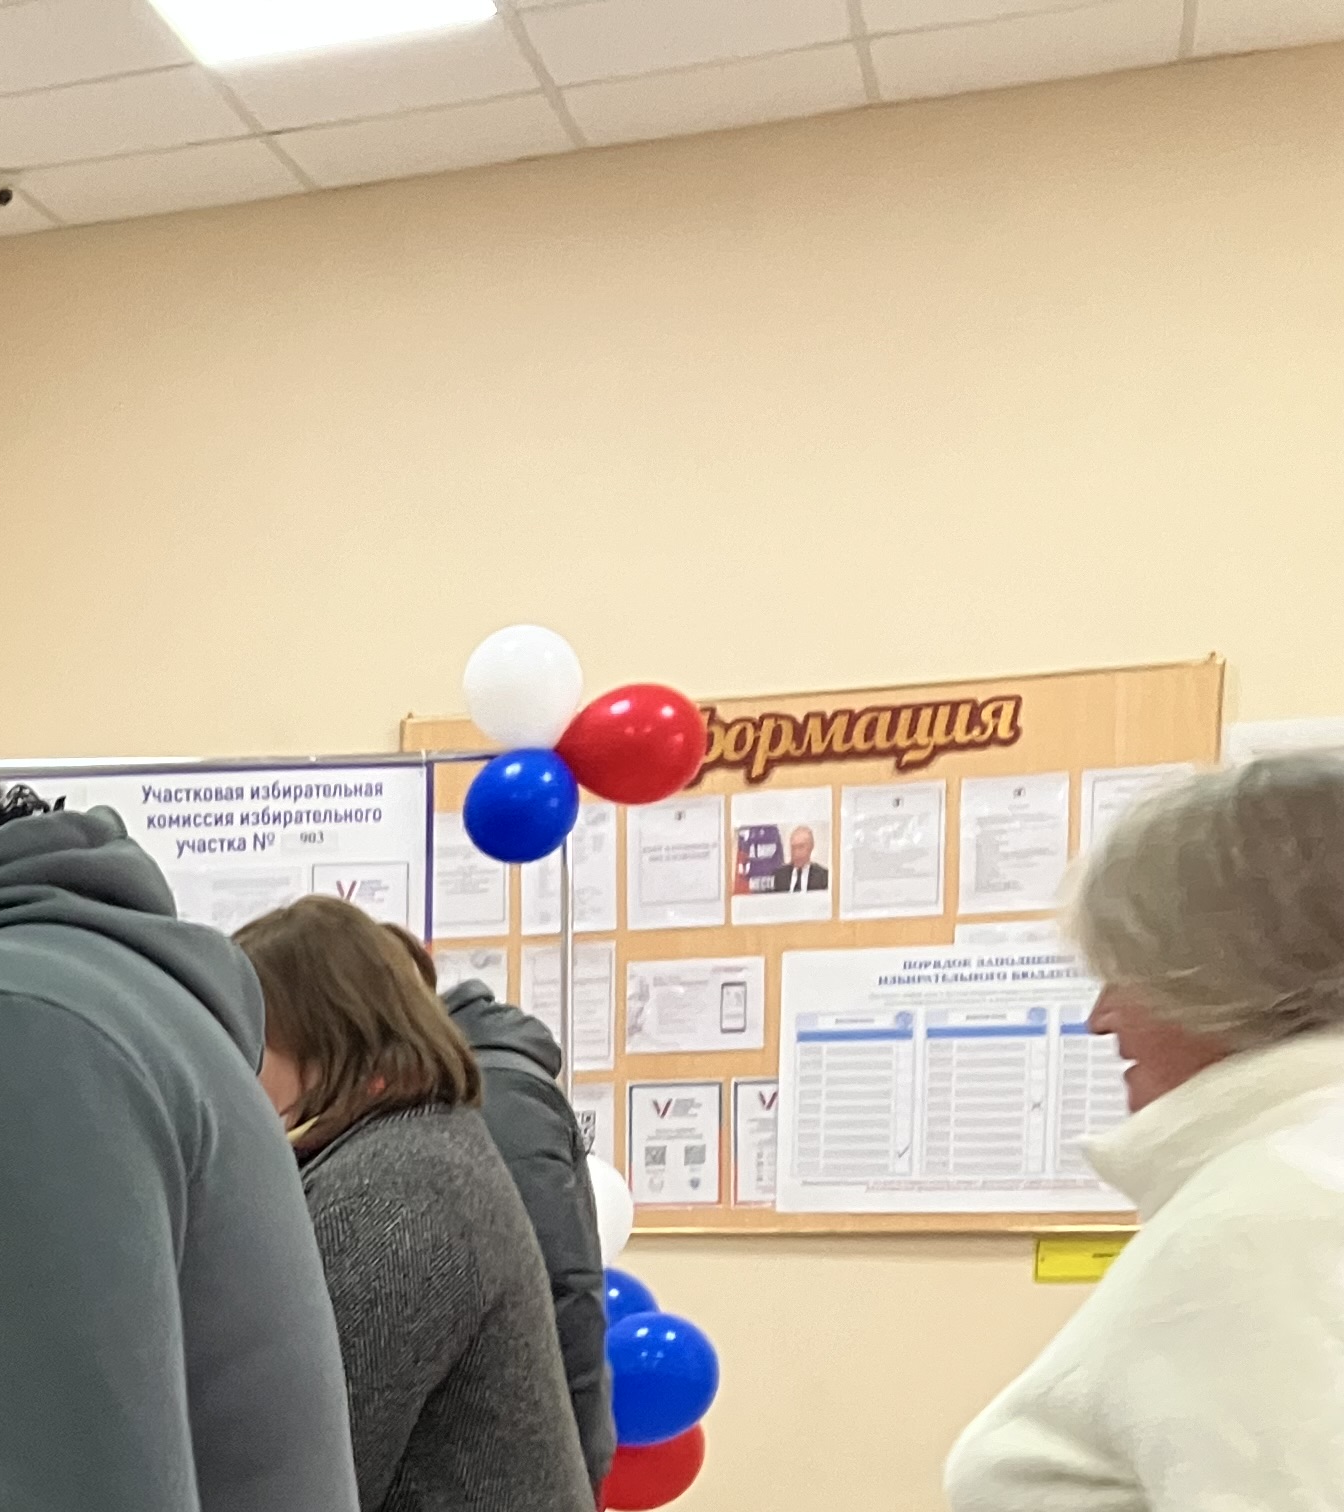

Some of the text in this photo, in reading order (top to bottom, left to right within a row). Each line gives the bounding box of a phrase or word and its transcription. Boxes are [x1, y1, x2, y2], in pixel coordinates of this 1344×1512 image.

[142, 780, 383, 804] Участковая избирательная
[147, 807, 382, 829] комиссия избирательного
[176, 836, 246, 858] участка
[252, 832, 276, 851] №
